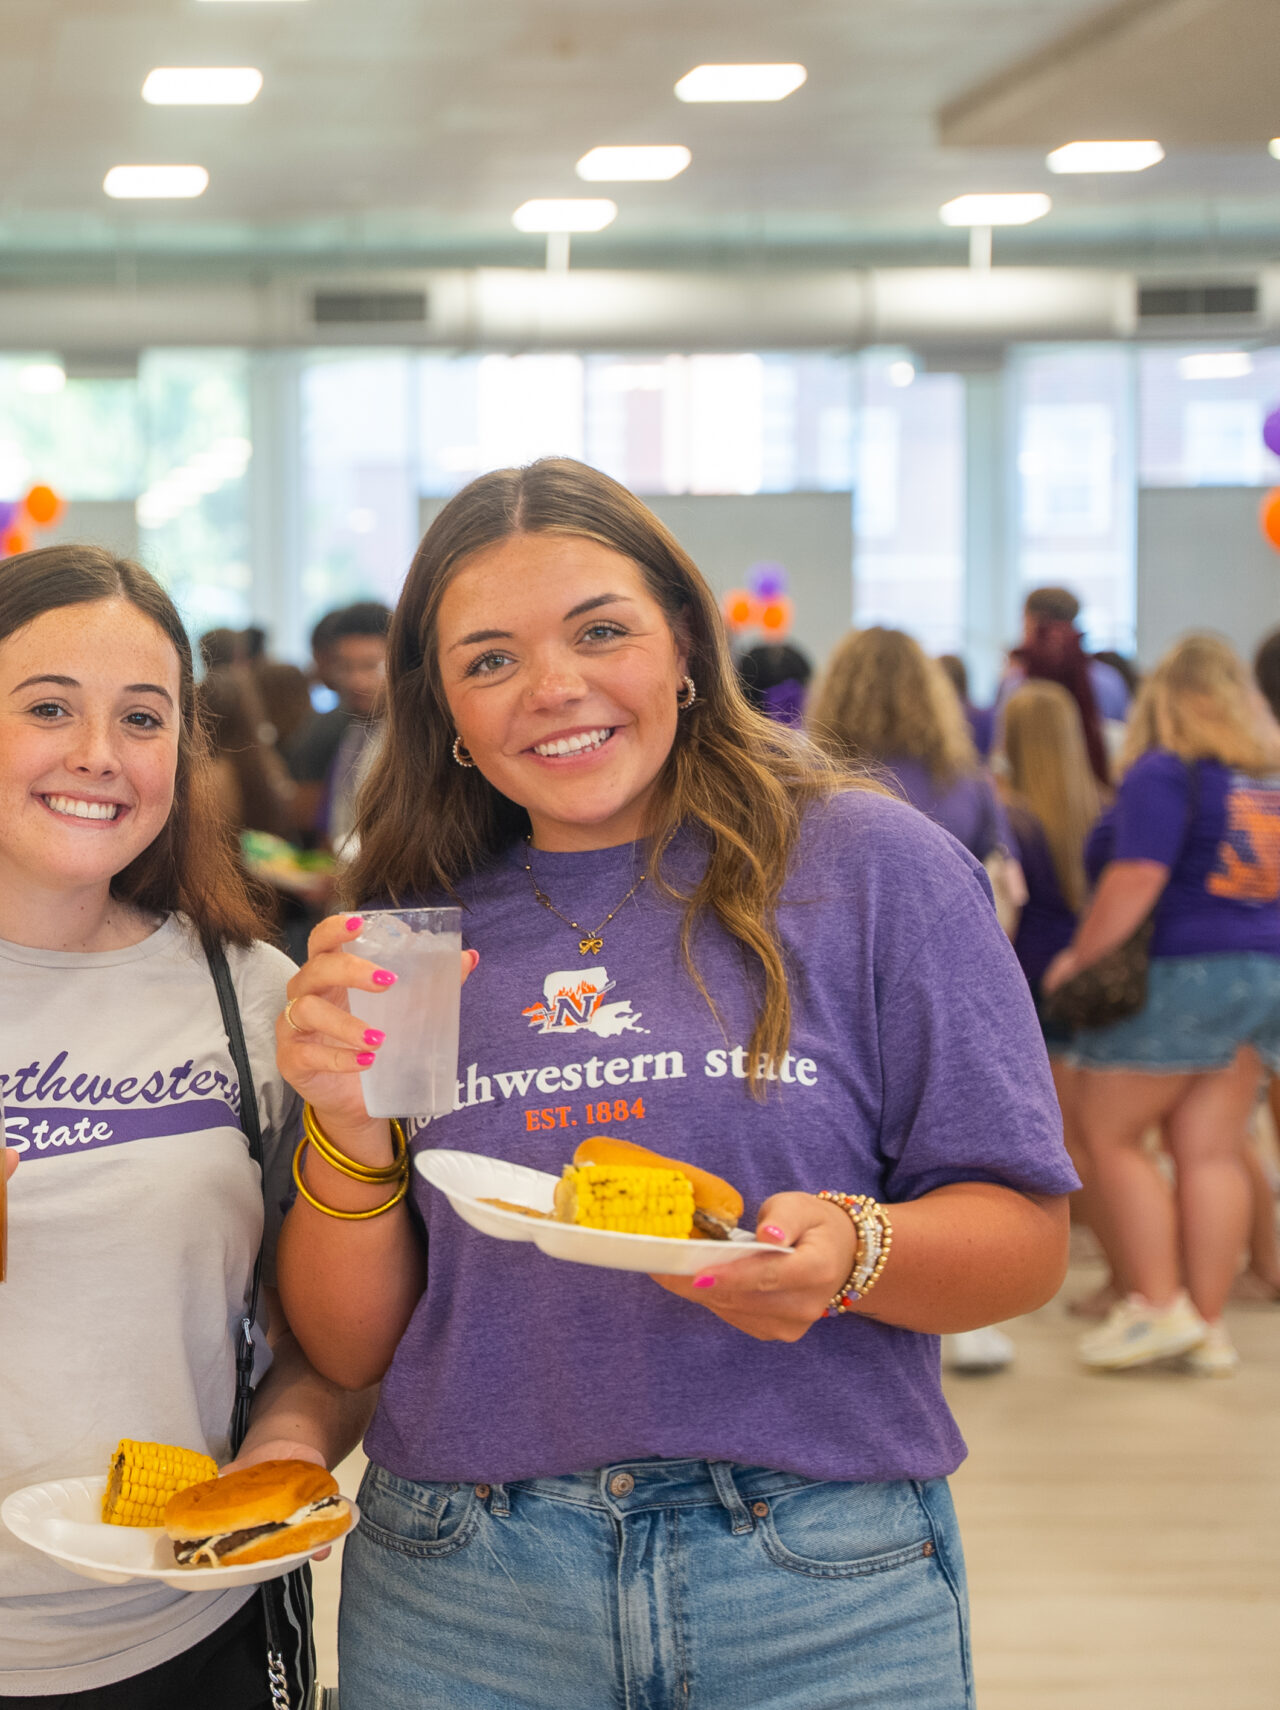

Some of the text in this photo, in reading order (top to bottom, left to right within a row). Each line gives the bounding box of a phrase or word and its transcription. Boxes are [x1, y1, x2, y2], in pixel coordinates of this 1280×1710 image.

[548, 993, 598, 1030] N
[406, 1049, 687, 1142] thwestern
[525, 1097, 646, 1132] EST. 1884
[4, 1115, 114, 1154] State
